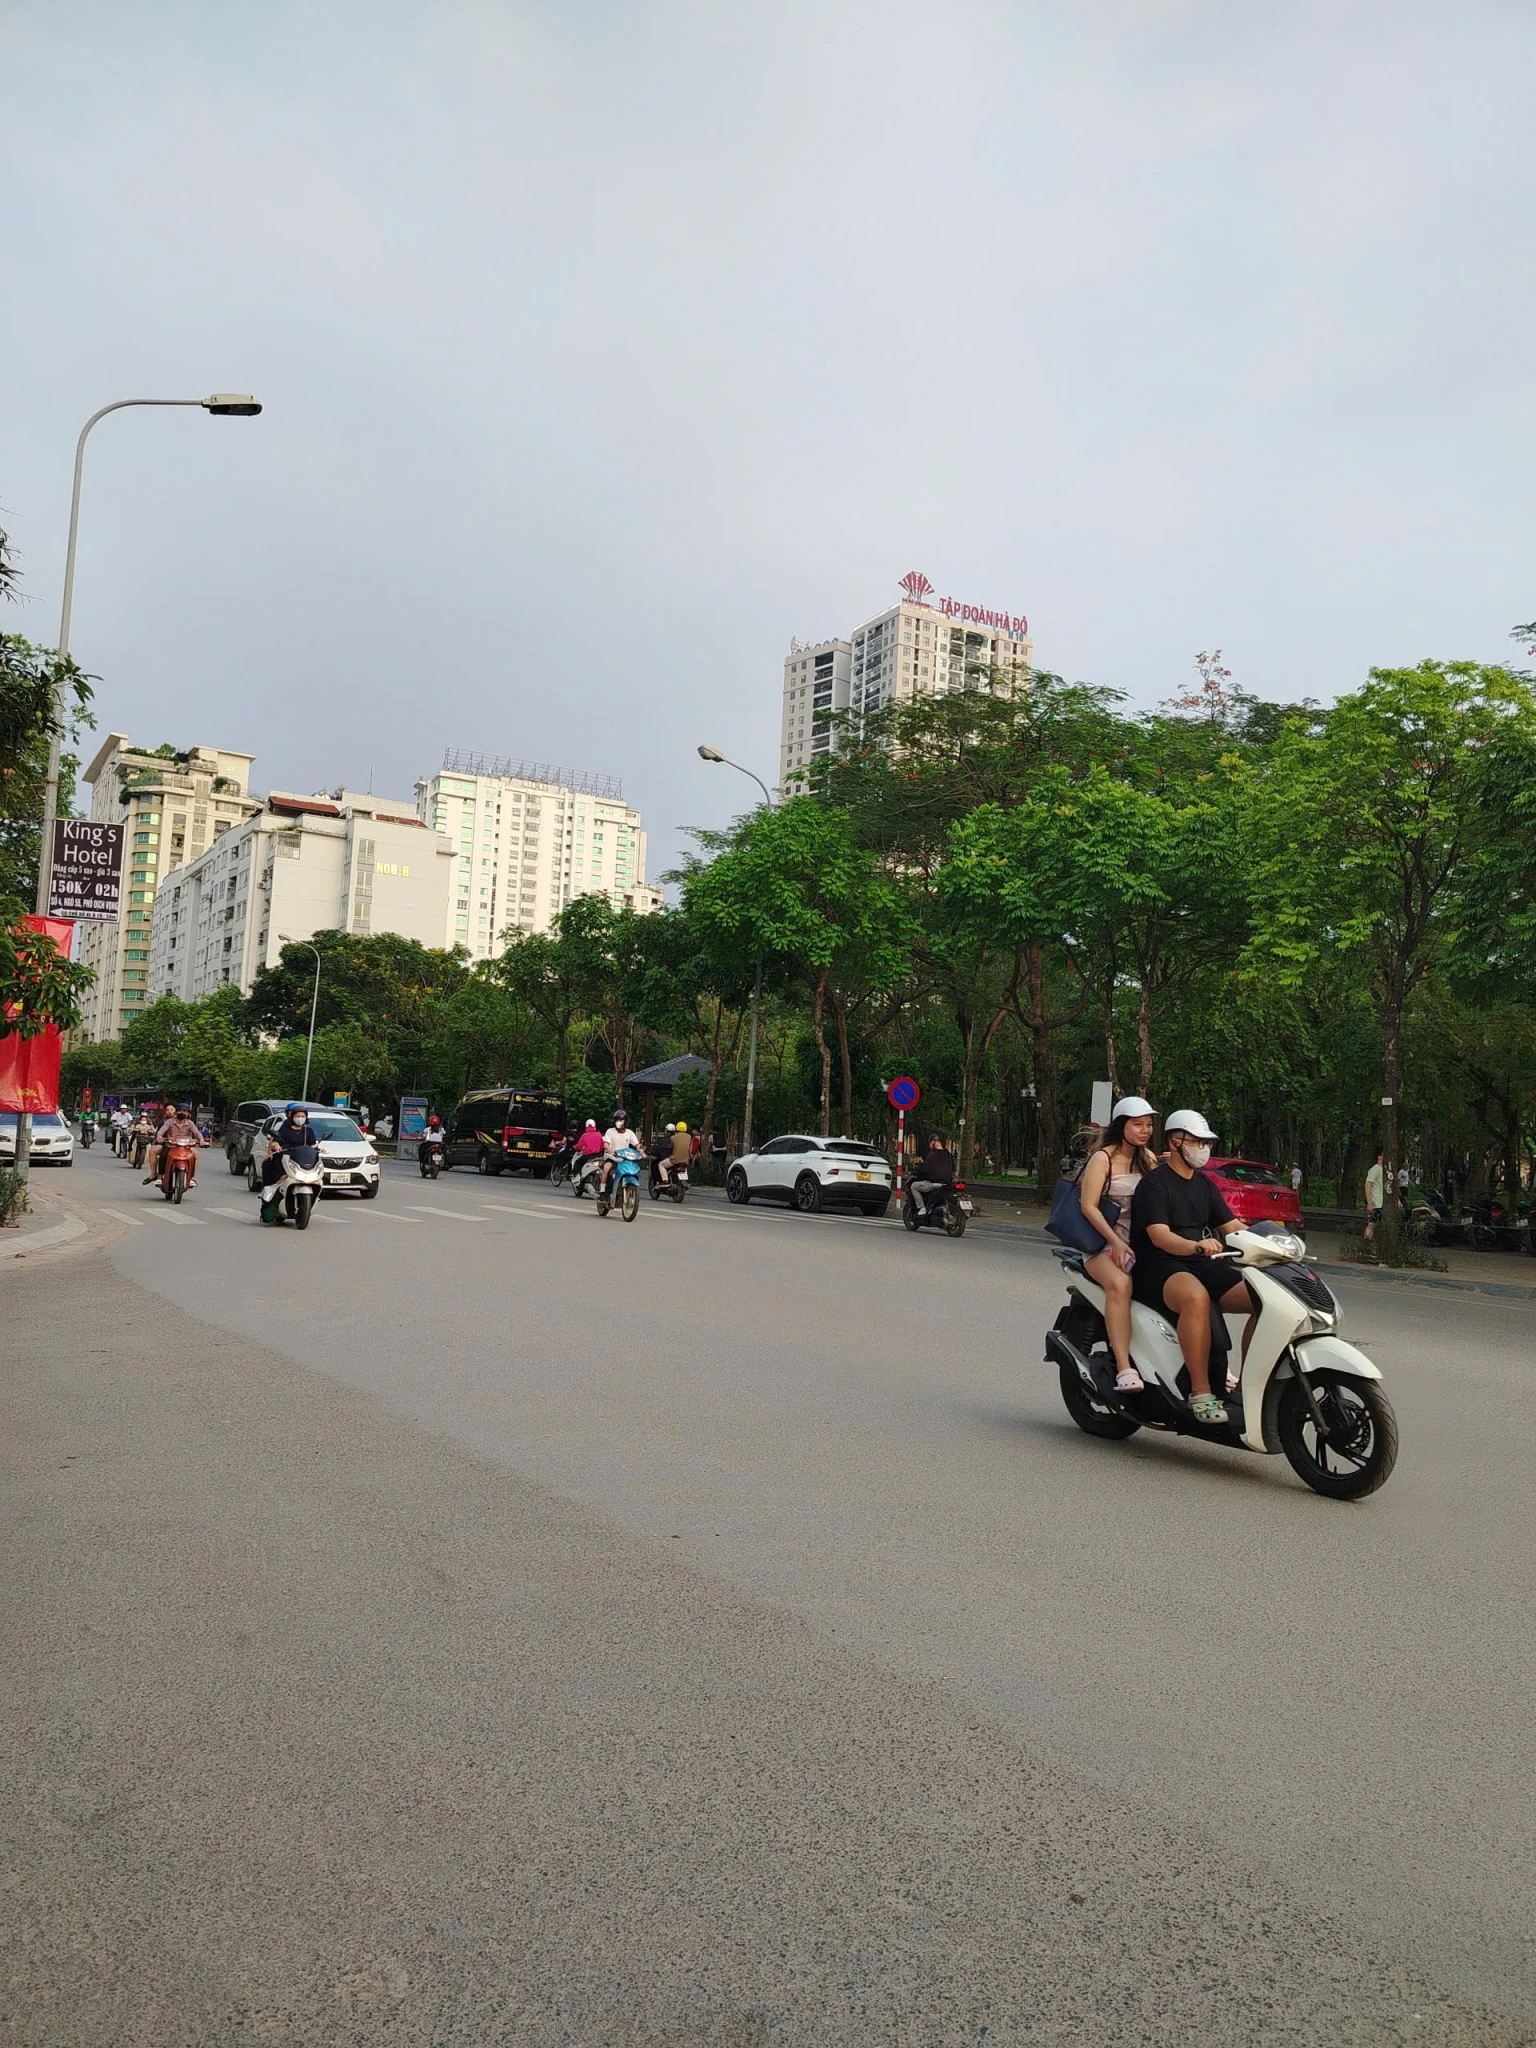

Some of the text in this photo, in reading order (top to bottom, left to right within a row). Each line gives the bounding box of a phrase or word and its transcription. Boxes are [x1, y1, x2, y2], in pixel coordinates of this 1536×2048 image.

[940, 596, 961, 619] TẬP
[963, 604, 994, 626] ĐOÀN
[995, 611, 1010, 631] HÀ
[1012, 616, 1028, 635] ĐÔ
[63, 820, 117, 846] King's
[63, 844, 113, 866] Hotel
[78, 865, 83, 874] 5
[83, 867, 93, 875] sao
[106, 868, 111, 876] 3
[51, 880, 119, 898] 150K/ 02h
[50, 894, 58, 906] SỐ
